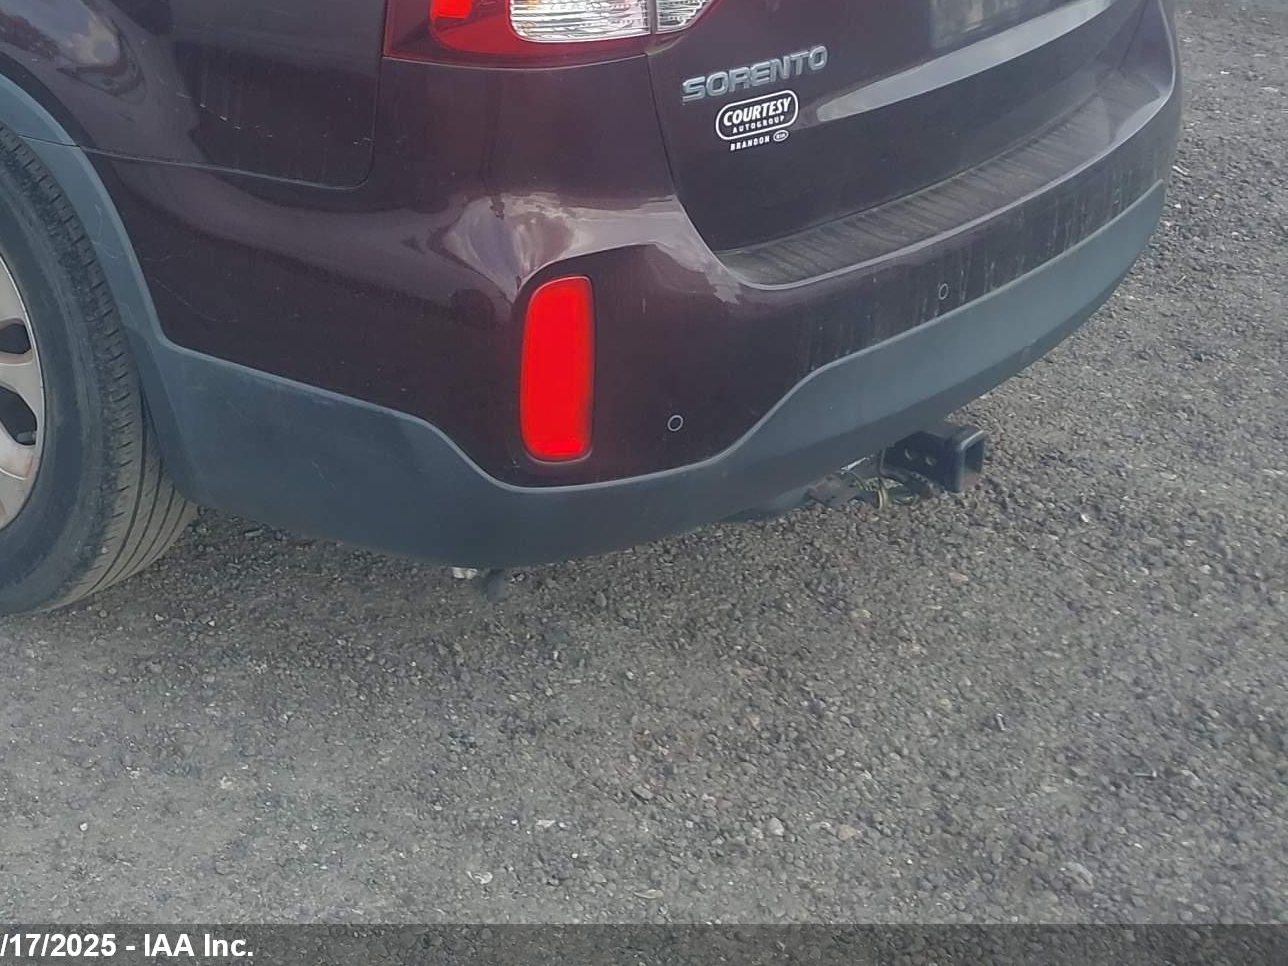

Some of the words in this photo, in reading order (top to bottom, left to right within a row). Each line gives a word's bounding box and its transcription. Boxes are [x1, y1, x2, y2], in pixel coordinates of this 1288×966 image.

[682, 45, 827, 102] SORENTO
[723, 97, 792, 126] COURTESY
[732, 115, 785, 134] AUTOGROUP
[730, 135, 770, 151] BRANDON
